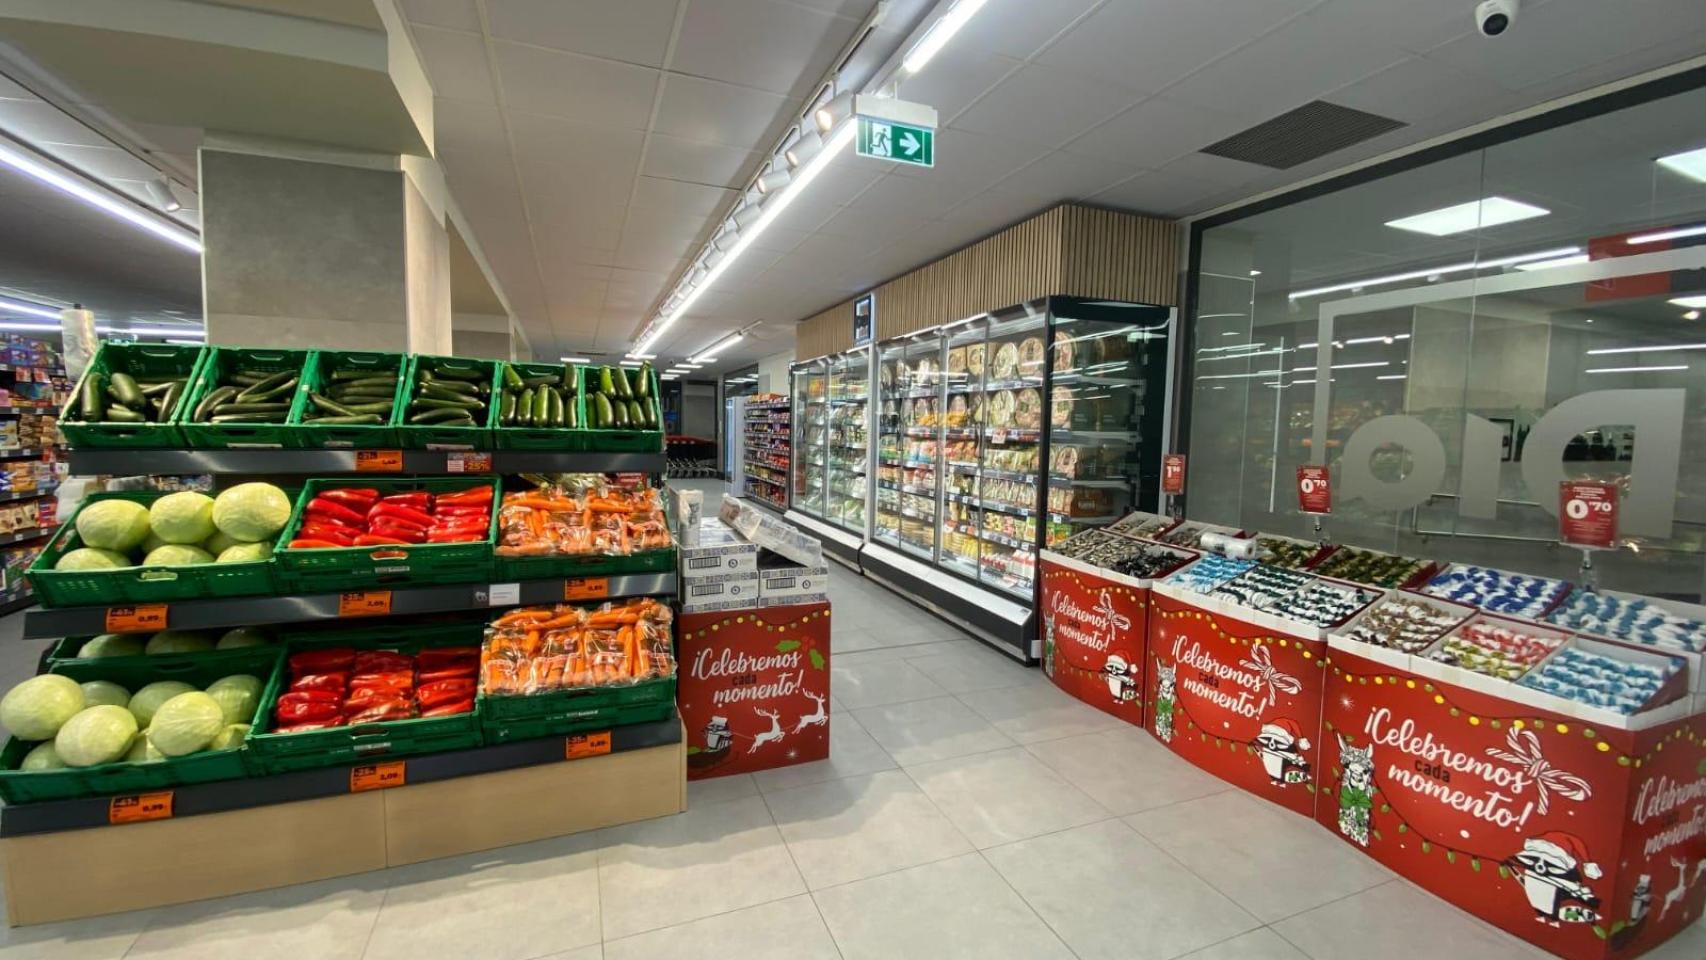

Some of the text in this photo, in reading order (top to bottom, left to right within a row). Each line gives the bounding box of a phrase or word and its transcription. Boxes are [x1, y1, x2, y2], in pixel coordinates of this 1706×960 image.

[1566, 499, 1613, 519] 0'70
[1051, 589, 1111, 631] ¡Celebremos
[1059, 623, 1111, 653] momento!
[691, 647, 803, 680] ¡Celebremos
[732, 674, 757, 686] cada
[1171, 634, 1266, 693] ¡Celebremos
[1198, 671, 1220, 689] cada
[713, 669, 804, 704] momento!
[1183, 677, 1268, 721] momento!
[1364, 706, 1532, 794] ¡Celebremos
[1414, 758, 1451, 783] cada
[1388, 763, 1534, 832] momento!
